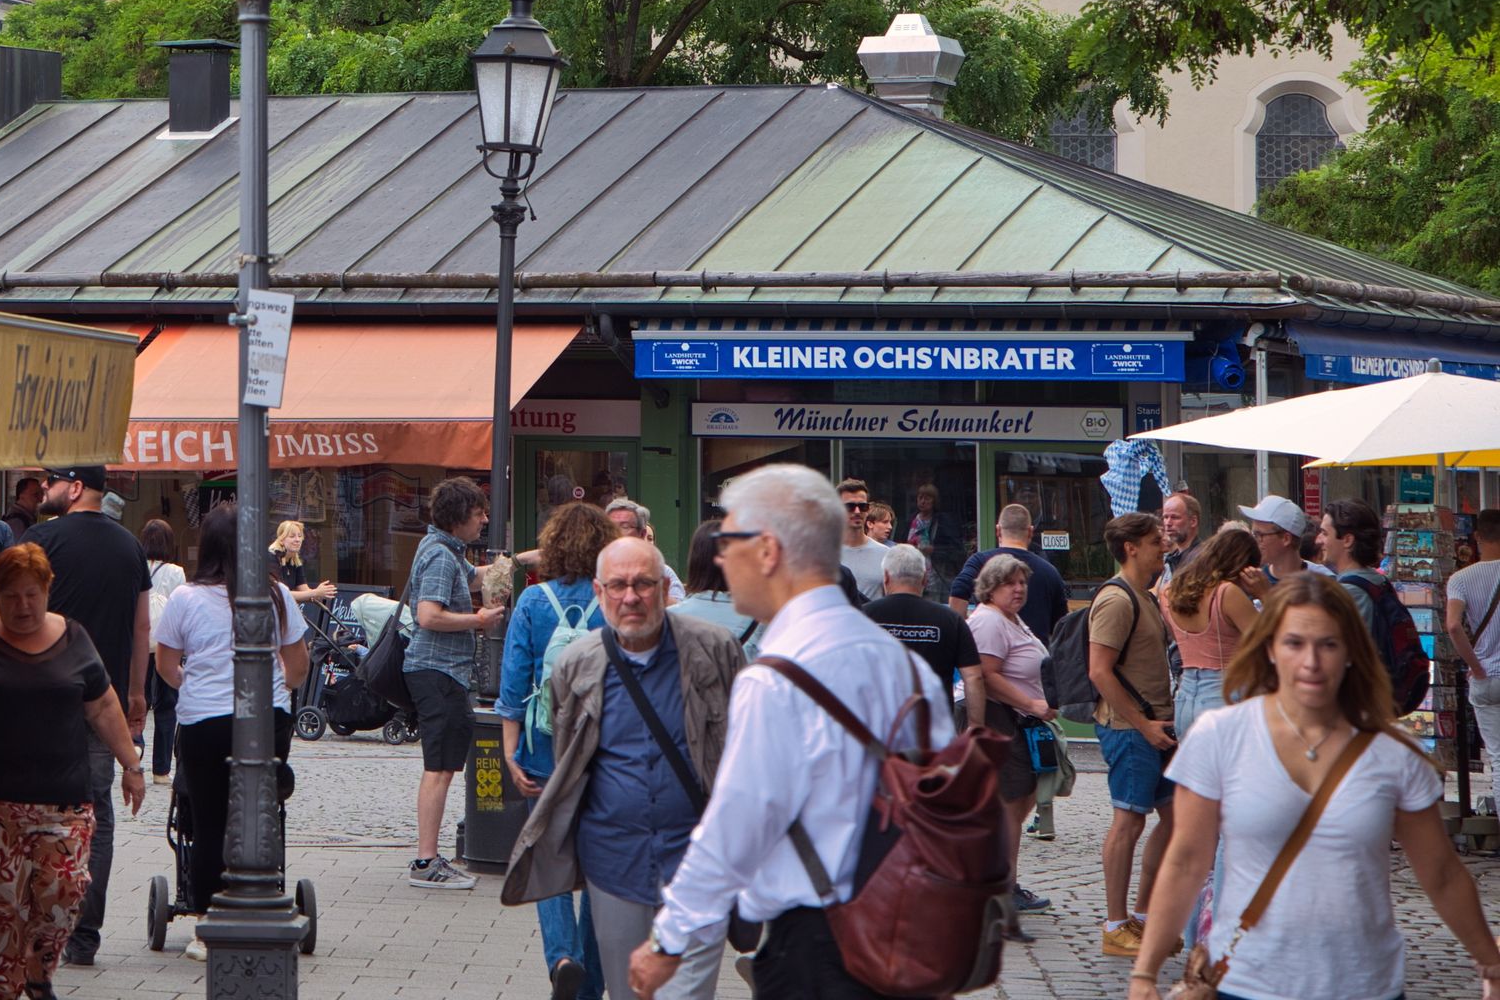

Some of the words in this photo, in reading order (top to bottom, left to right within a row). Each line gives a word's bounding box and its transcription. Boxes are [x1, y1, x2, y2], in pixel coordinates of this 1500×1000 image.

[248, 301, 287, 314] ngsweg
[248, 339, 274, 348] alten
[733, 347, 847, 369] KLEINER
[853, 346, 1076, 370] OCHS'NBRATER
[1136, 406, 1161, 415] Stand
[774, 407, 889, 431] Münchner
[897, 409, 1034, 433] Schmankerl
[1143, 418, 1154, 431] 11
[274, 433, 379, 458] IMBISS
[1042, 535, 1068, 547] CLOSED
[886, 628, 937, 638] ctrocraft
[476, 757, 501, 769] REIN
